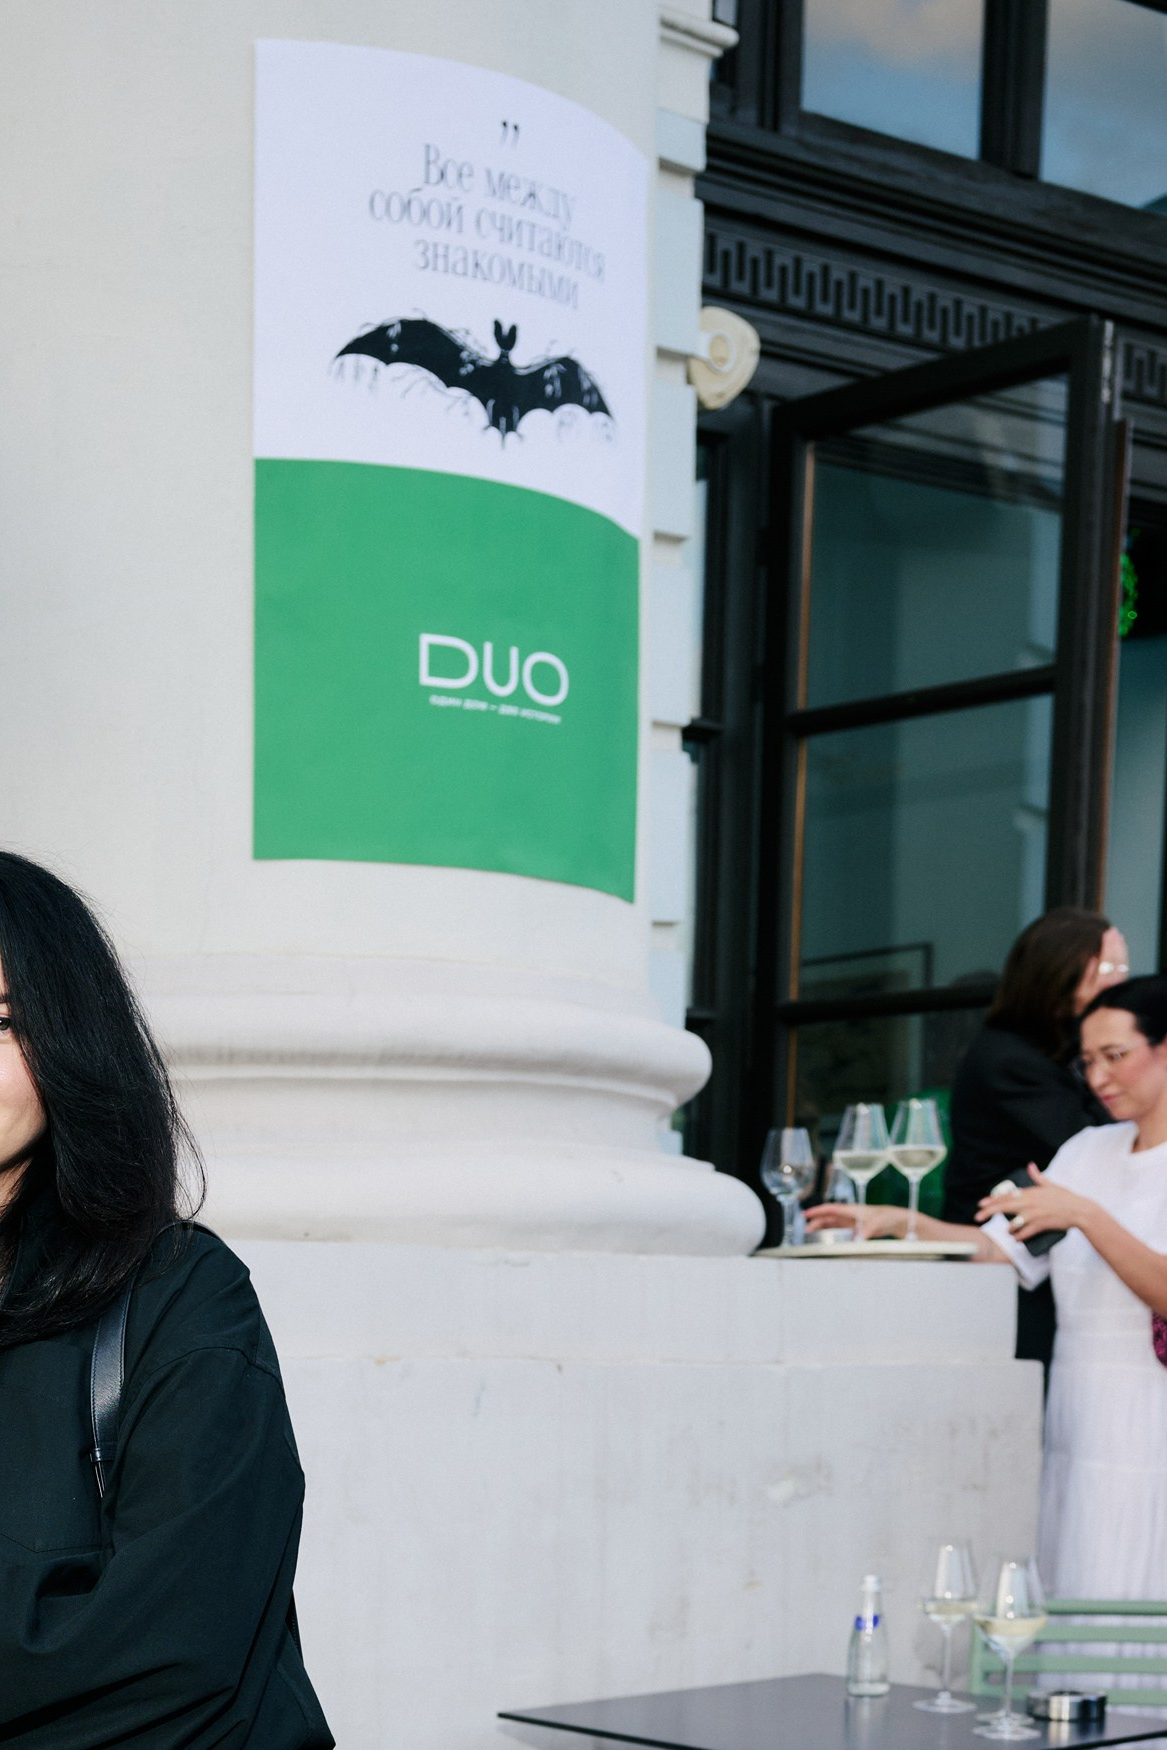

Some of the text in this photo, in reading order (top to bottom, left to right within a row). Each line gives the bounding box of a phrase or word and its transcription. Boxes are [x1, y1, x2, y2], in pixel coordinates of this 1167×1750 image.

[422, 142, 576, 231] Все между
[368, 187, 607, 283] собой считаются
[413, 238, 580, 310] знакомыми
[418, 632, 570, 707] DUO
